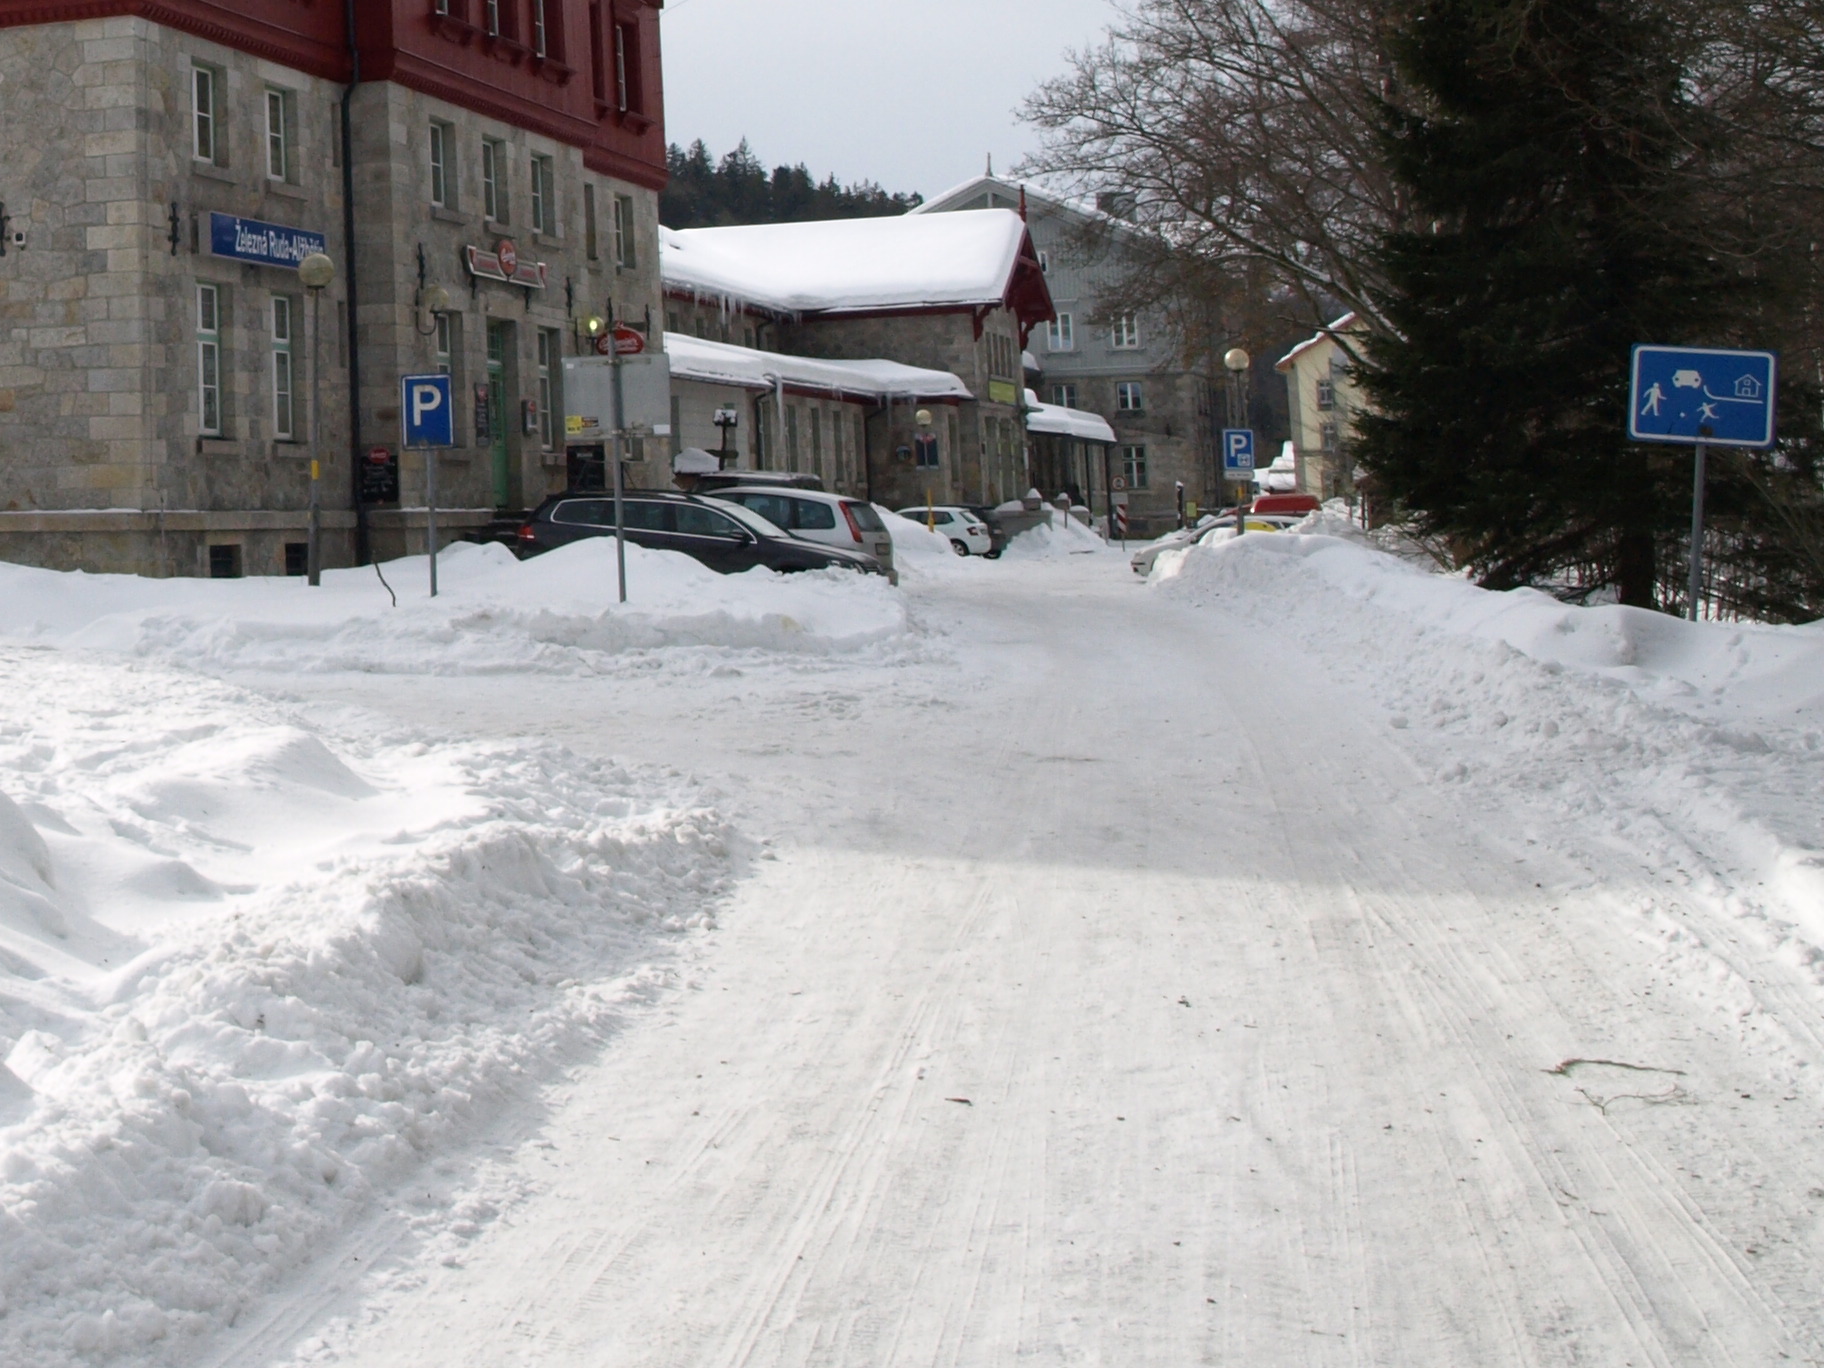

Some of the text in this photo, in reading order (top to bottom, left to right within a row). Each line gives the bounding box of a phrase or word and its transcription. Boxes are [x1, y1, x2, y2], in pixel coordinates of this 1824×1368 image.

[234, 219, 268, 255] Železná
[413, 384, 441, 426] P
[1229, 434, 1247, 457] P
